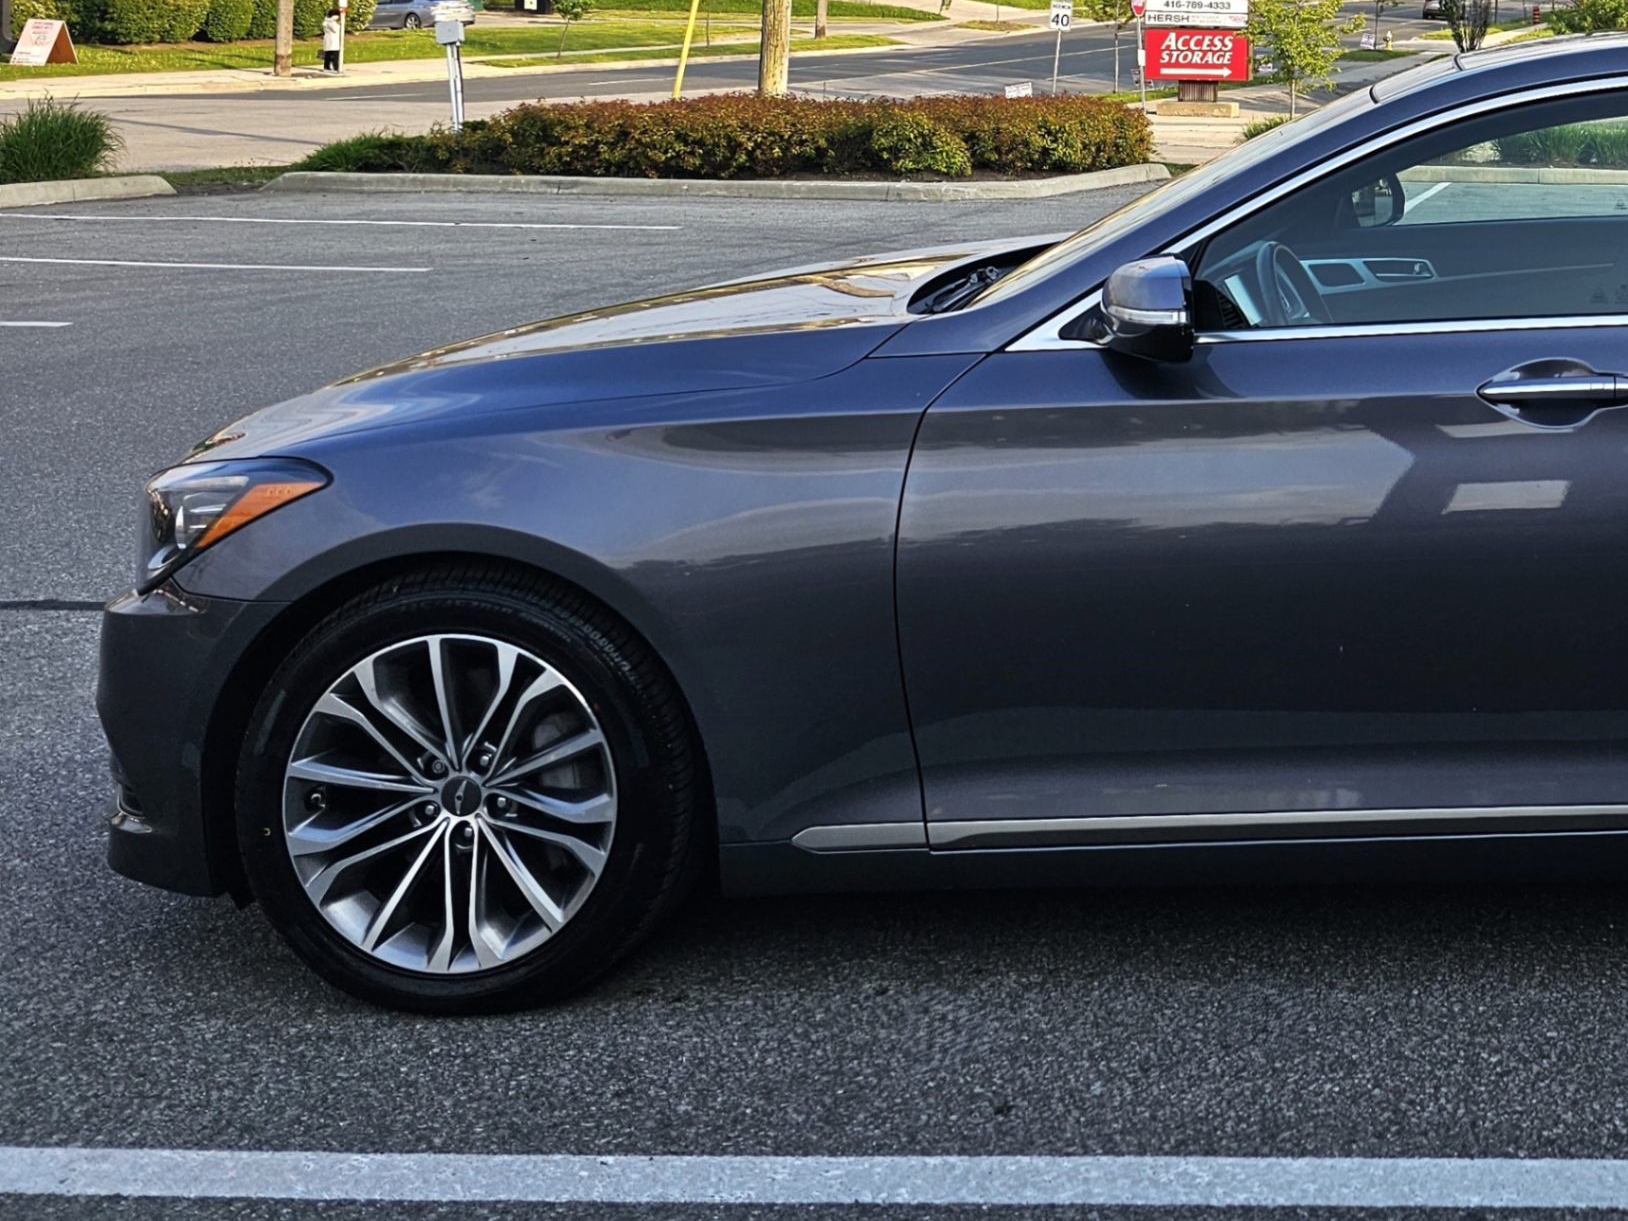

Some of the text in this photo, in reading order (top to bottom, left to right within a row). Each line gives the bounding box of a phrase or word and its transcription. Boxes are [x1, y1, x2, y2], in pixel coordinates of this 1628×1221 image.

[1164, 0, 1231, 10] 416-789-4333
[1051, 13, 1070, 27] 40
[1147, 14, 1190, 23] HERSH
[1161, 32, 1234, 51] ACCESS
[1160, 50, 1233, 64] STORAGE
